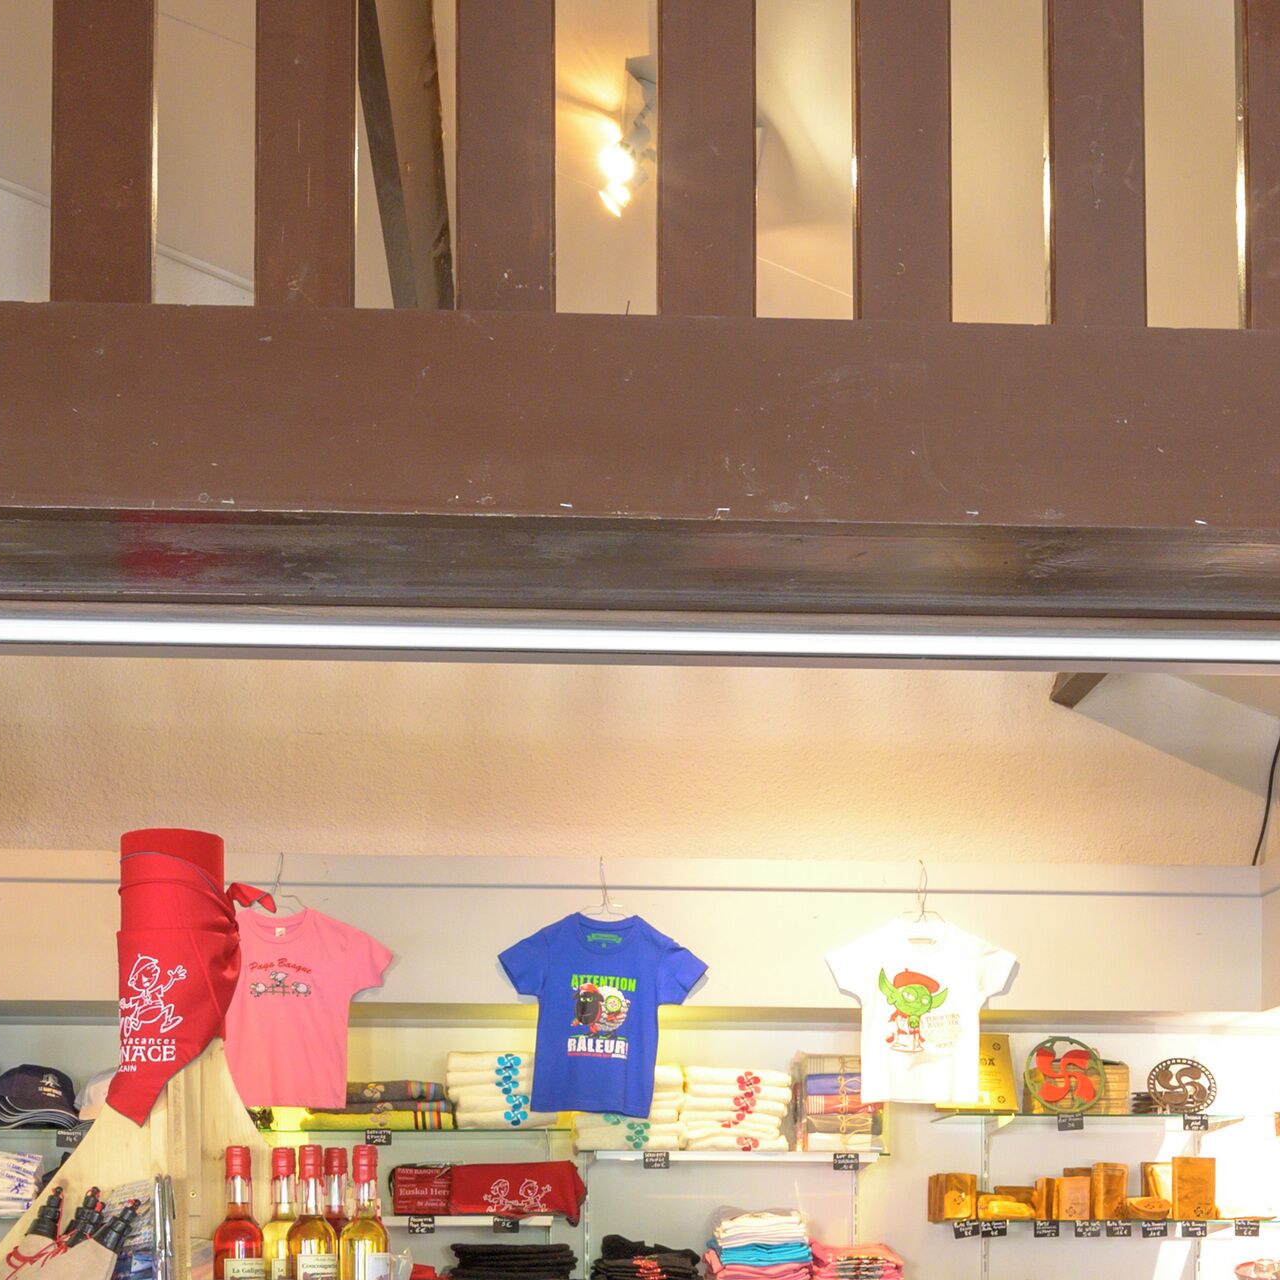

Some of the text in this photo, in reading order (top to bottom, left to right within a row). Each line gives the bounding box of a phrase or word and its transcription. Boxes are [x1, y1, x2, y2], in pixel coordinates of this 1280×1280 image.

[249, 958, 313, 975] Pays Basque
[570, 973, 637, 992] ATTENTION
[121, 1045, 176, 1062] NACE
[399, 1187, 428, 1196] Euskal
